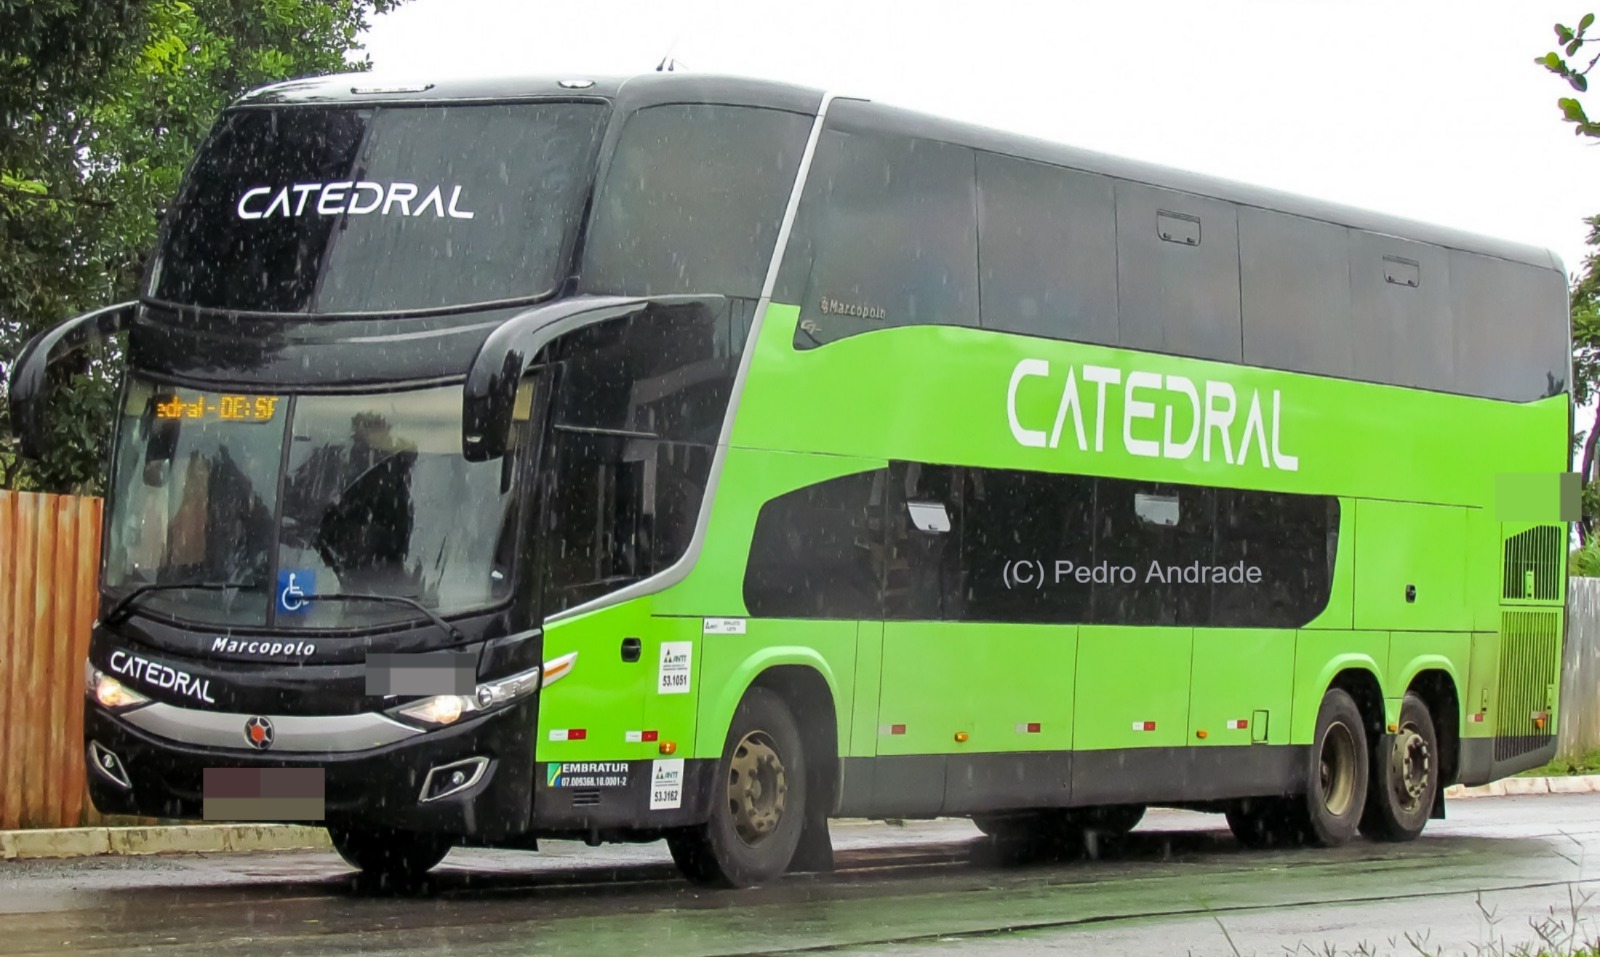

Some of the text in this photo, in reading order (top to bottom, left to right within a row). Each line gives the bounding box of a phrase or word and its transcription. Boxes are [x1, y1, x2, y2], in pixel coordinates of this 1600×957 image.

[238, 181, 474, 219] CATEDRAL
[829, 299, 886, 319] Marcopolo
[1007, 358, 1299, 472] CATEDRAL
[211, 637, 315, 656] Marcopolo
[110, 651, 215, 703] CATEDRAL
[662, 675, 687, 687] 53.1051
[562, 763, 629, 773] EMBRATUR
[654, 790, 678, 802] 53.3162
